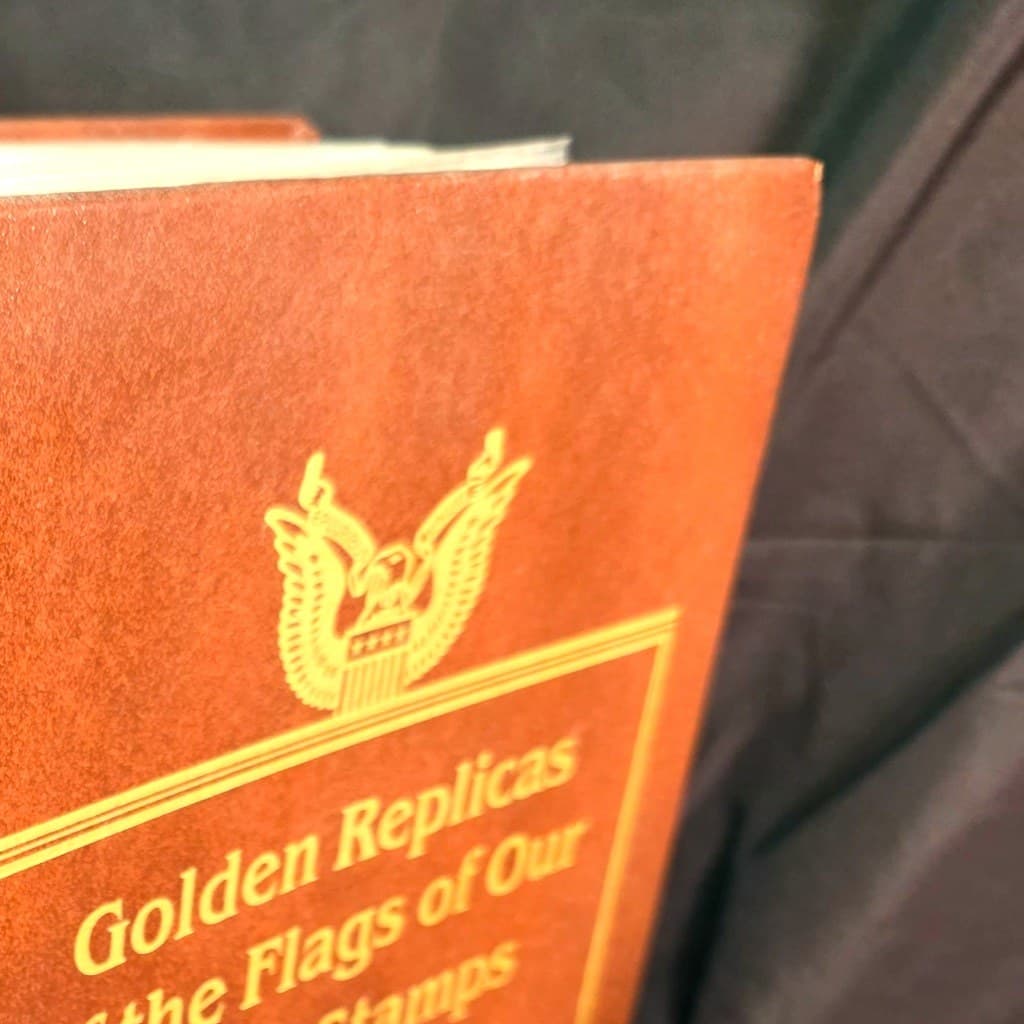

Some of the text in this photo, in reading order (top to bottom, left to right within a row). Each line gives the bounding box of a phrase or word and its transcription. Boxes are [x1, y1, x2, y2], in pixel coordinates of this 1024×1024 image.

[73, 736, 580, 977] Golden Replicas
[239, 895, 407, 1012] Flags
[416, 847, 485, 927] of
[484, 818, 590, 897] Our
